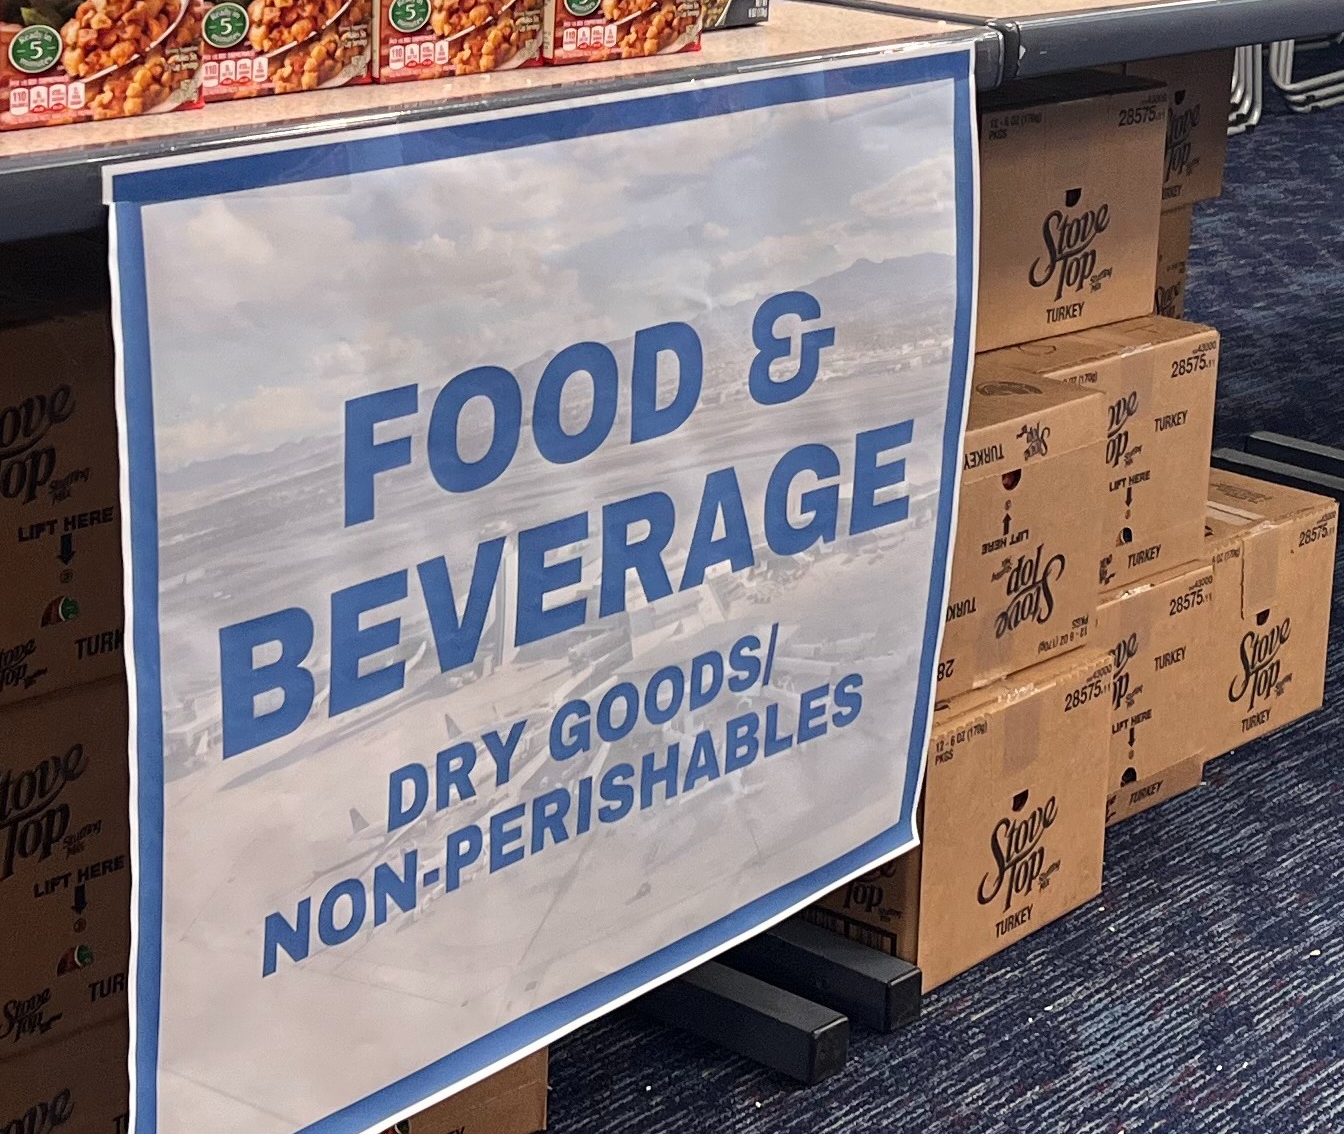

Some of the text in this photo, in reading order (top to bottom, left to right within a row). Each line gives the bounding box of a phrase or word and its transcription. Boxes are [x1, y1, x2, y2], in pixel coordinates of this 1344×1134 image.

[220, 17, 232, 35] 5
[405, 3, 416, 21] 5
[30, 40, 43, 60] 5
[1028, 203, 1111, 288] Stove
[1053, 248, 1098, 302] Top
[1046, 302, 1086, 324] TURKEY
[344, 290, 836, 528] FOOD &
[1154, 410, 1188, 433] TURKEY
[1109, 470, 1151, 493] LIFT HERE
[18, 506, 115, 543] LIFT HERE
[982, 537, 1008, 556] HERE
[1127, 545, 1161, 569] TURKEY
[1006, 543, 1045, 596] Top
[218, 419, 915, 759] BEVERAGE
[995, 553, 1066, 639] Stove
[1154, 646, 1187, 672] TURKEY
[1228, 618, 1291, 703] Stove
[1248, 658, 1281, 713] Top
[386, 623, 780, 834] DRY GOODS/
[1112, 709, 1153, 734] LIFT HERE
[1241, 708, 1271, 733] TURKEY
[1129, 780, 1163, 806] TURKEY
[262, 673, 864, 979] NON-PERISHABLES
[977, 795, 1058, 905] Stove
[33, 854, 126, 900] LIFT HERE
[1003, 845, 1045, 914] Top
[995, 903, 1033, 939] TURKEY
